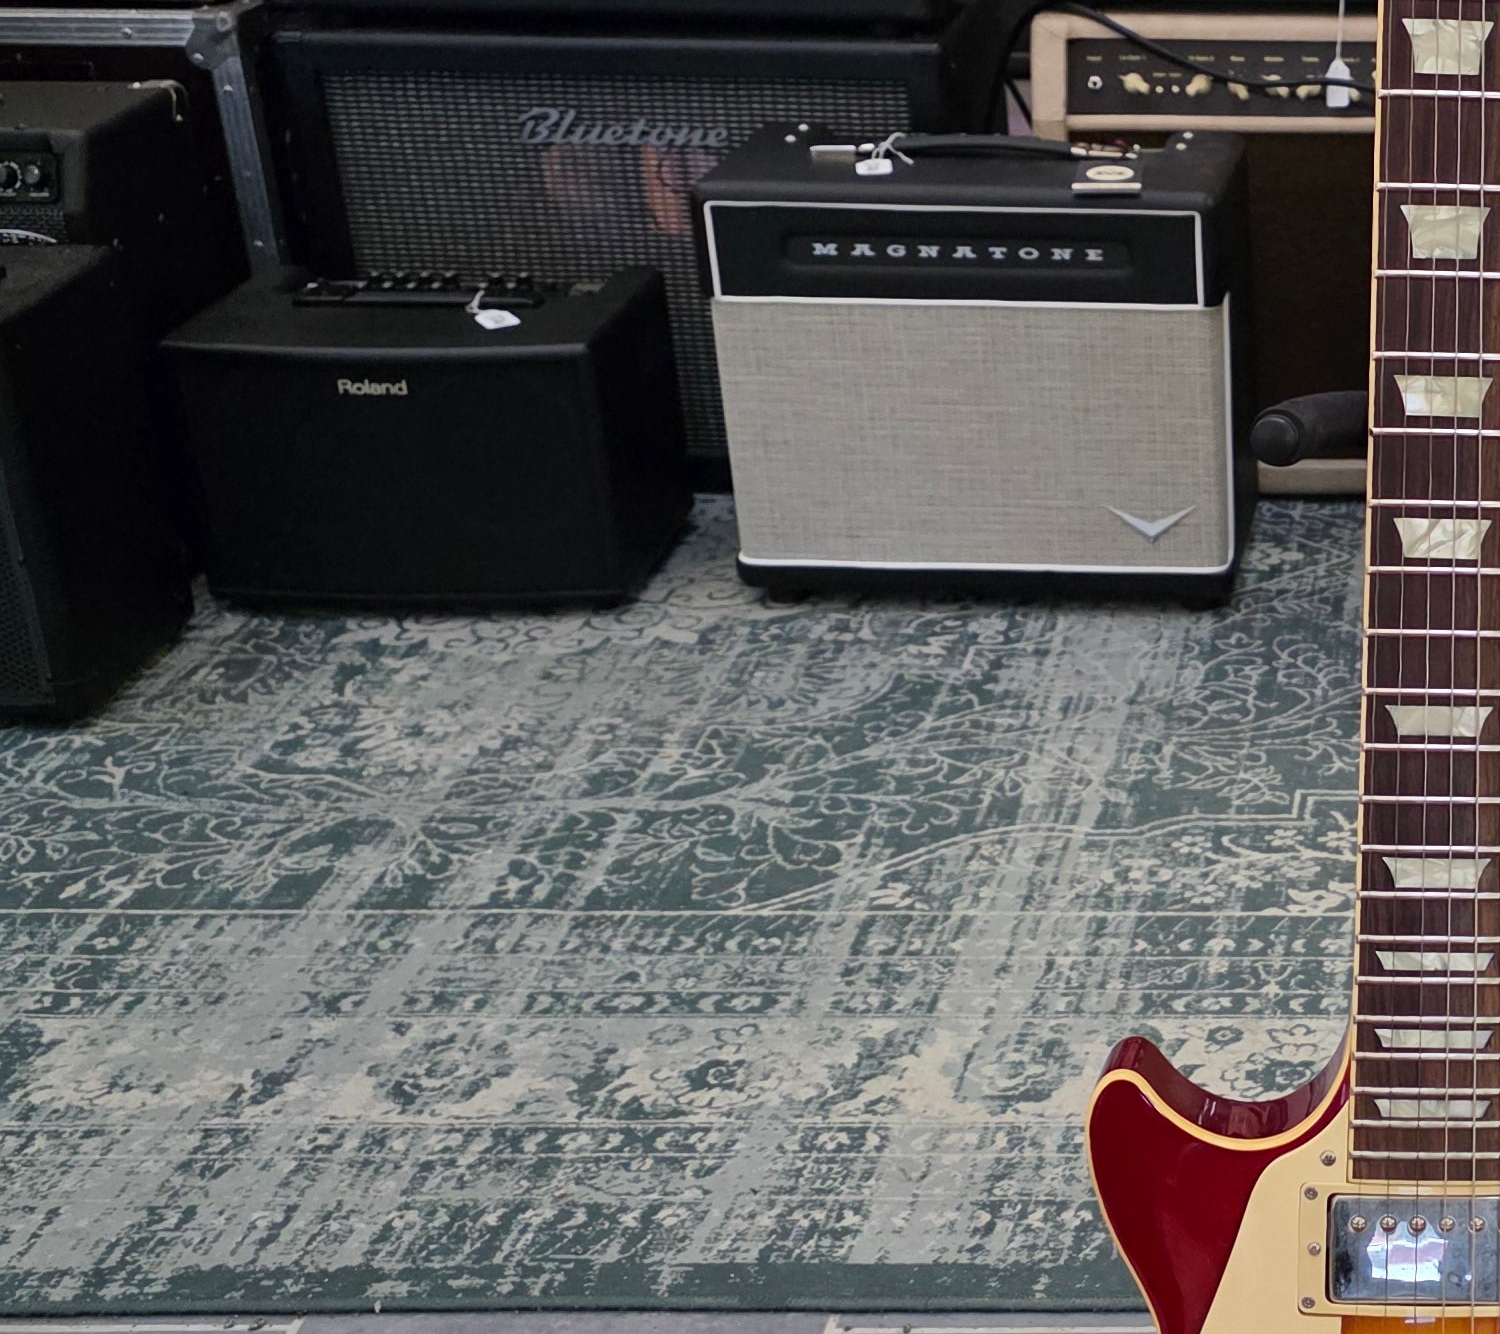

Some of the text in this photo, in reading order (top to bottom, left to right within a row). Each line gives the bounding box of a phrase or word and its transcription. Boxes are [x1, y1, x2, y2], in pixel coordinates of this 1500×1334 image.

[520, 106, 729, 147] Bluetone
[811, 242, 1104, 261] MAGNATONE
[337, 378, 409, 396] Roland
